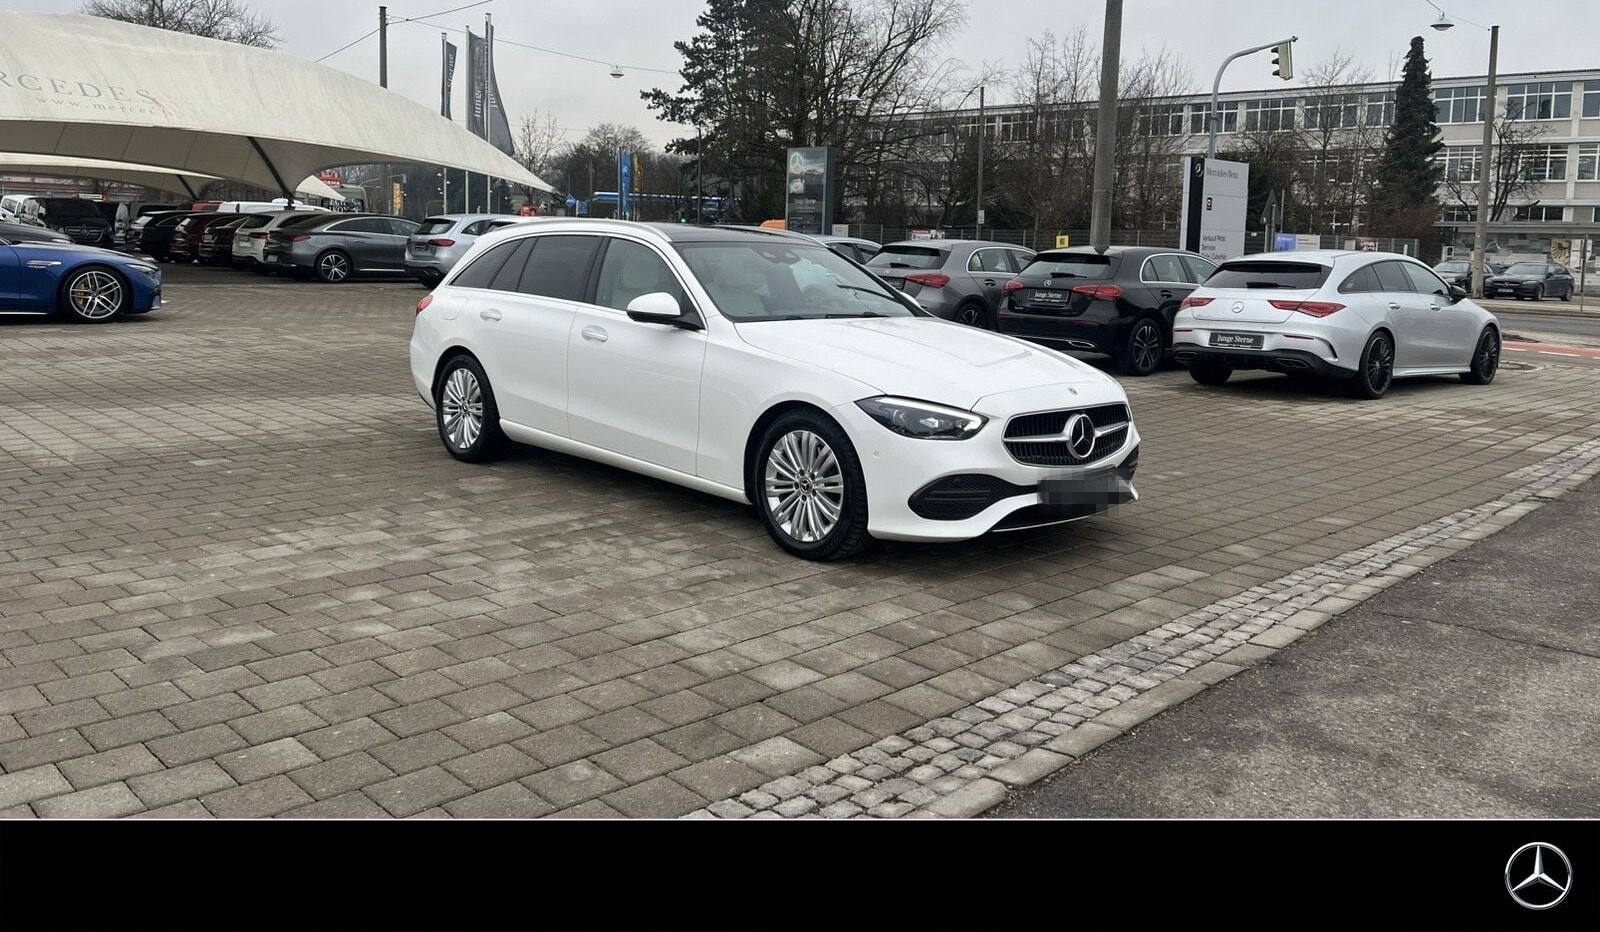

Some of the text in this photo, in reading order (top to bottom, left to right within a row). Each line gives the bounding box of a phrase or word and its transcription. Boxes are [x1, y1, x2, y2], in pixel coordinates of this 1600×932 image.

[1034, 291, 1063, 299] Junge Sterne
[1217, 335, 1233, 343] Junge
